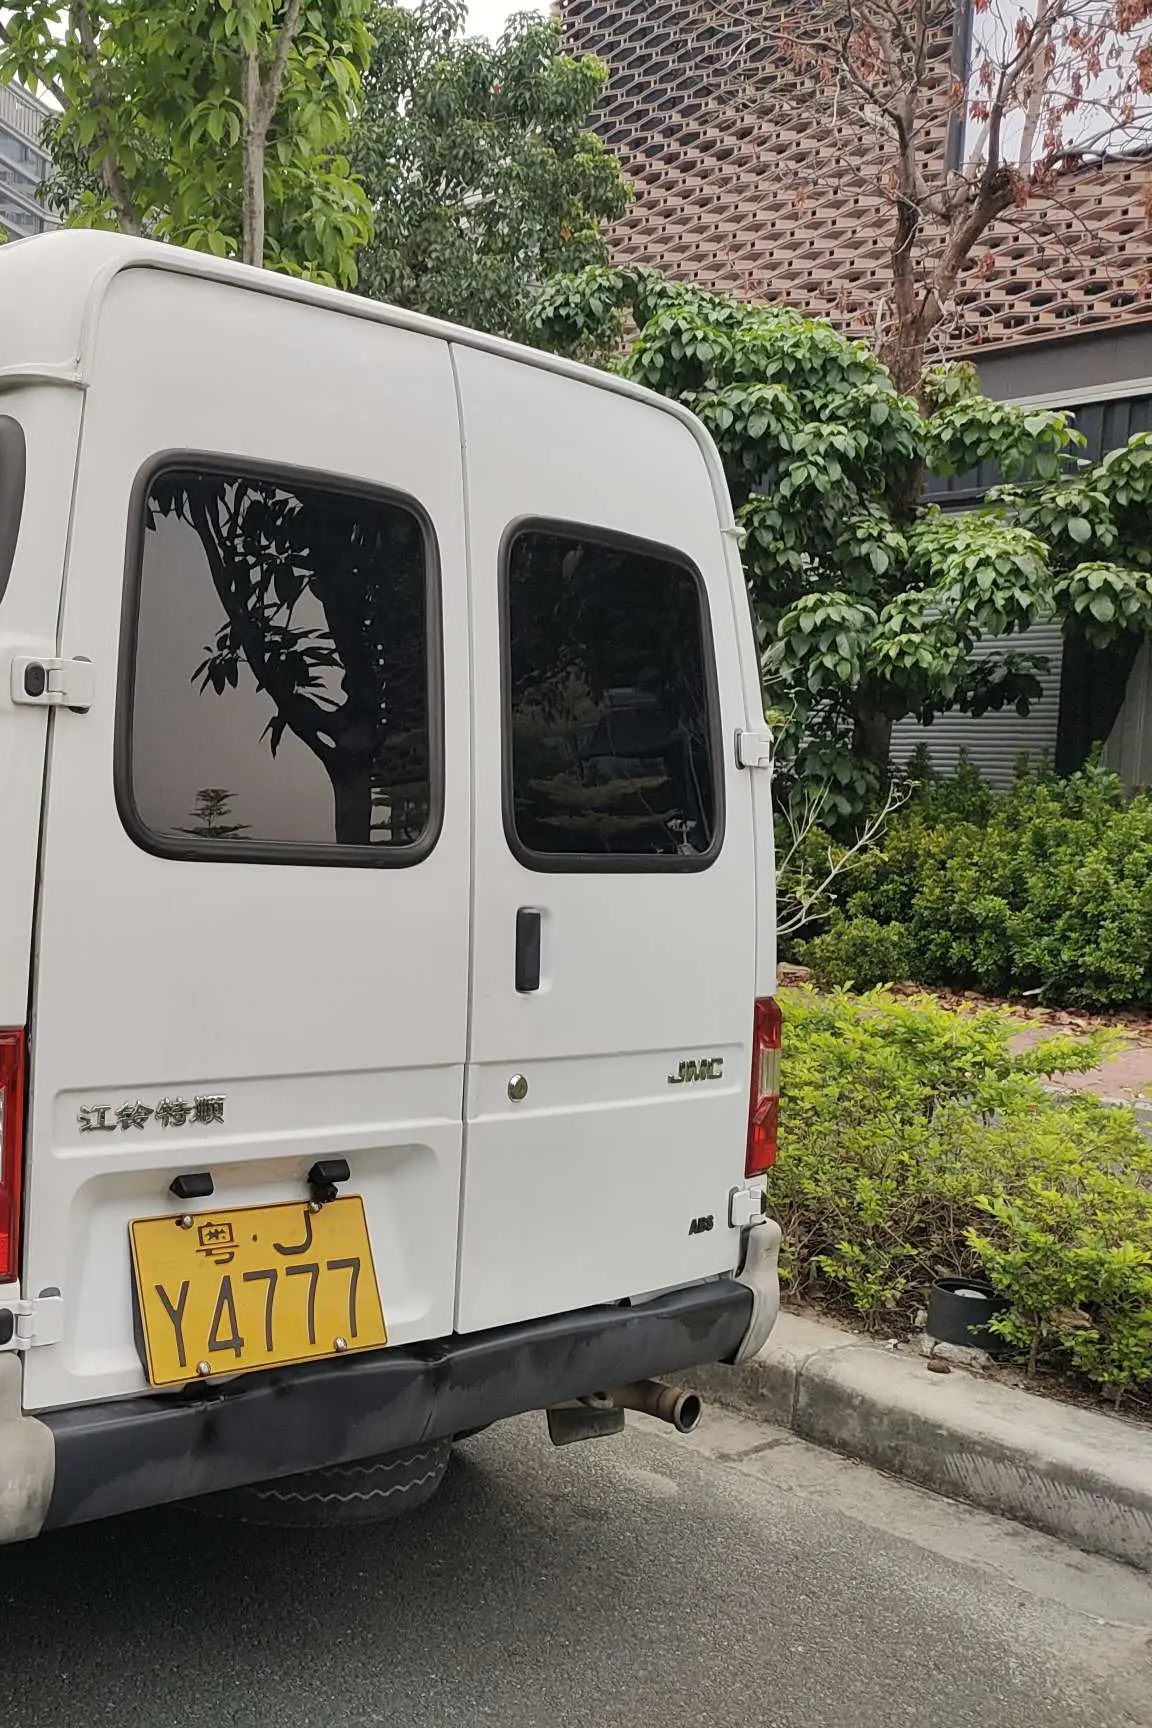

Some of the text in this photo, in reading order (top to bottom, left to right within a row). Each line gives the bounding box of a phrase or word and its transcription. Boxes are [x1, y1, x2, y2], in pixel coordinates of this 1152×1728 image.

[667, 1057, 723, 1083] JMC
[77, 1093, 227, 1133] 江铃特顺
[688, 1214, 714, 1235] ABS
[155, 1257, 360, 1367] Y4777
